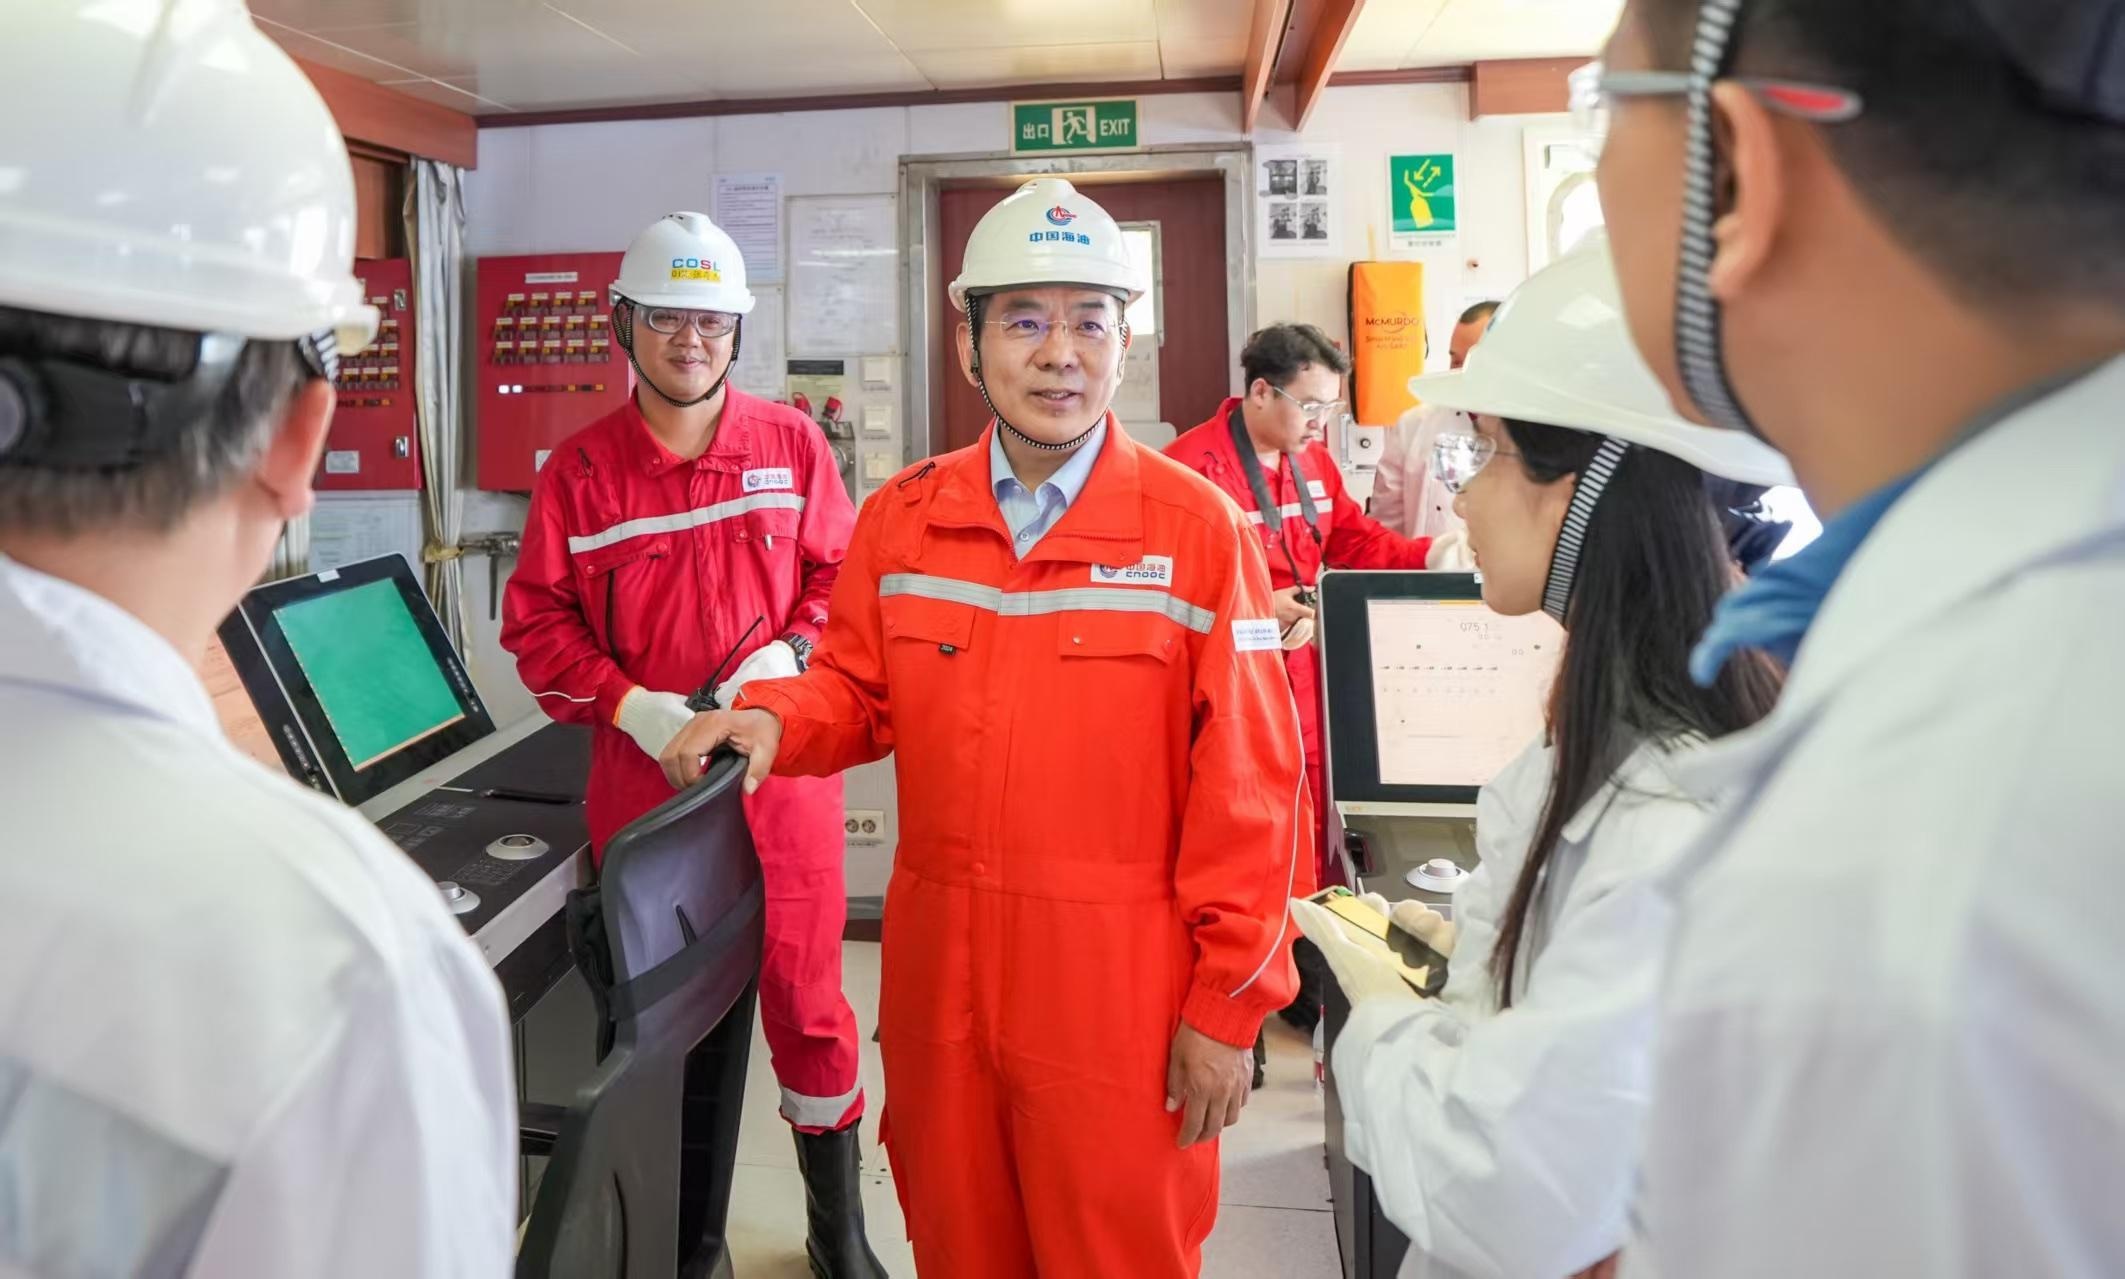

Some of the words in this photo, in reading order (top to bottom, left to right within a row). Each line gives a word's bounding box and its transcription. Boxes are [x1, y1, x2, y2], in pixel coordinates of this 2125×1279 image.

[1023, 123, 1049, 140] 出口
[1100, 118, 1131, 136] EXIT
[1029, 231, 1091, 246] 中国海油
[672, 258, 720, 271] COSL
